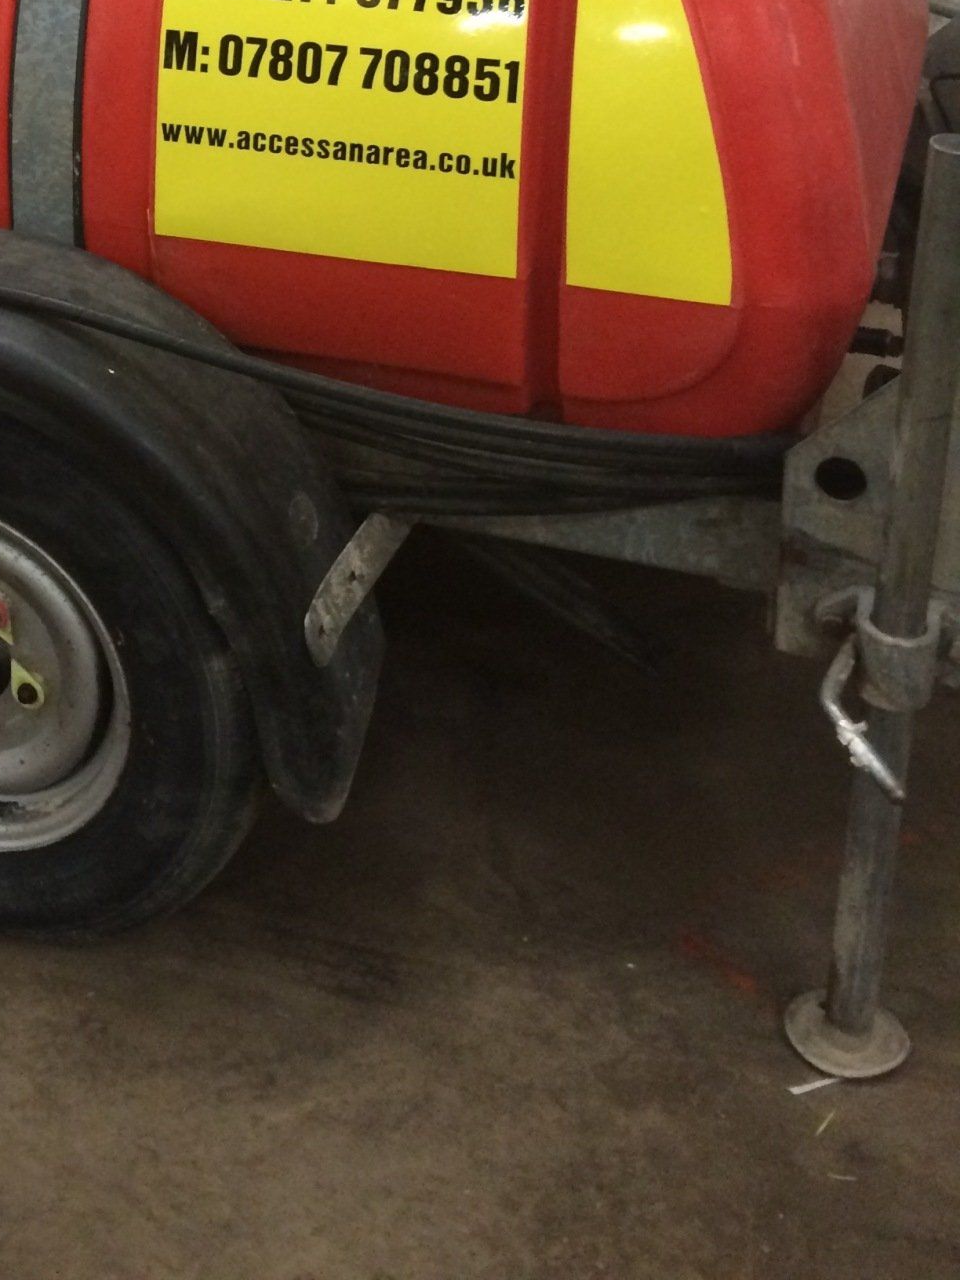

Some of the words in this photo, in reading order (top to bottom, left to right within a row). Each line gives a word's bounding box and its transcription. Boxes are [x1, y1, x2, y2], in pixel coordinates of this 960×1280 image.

[162, 29, 210, 74] M:
[217, 33, 348, 87] 07807
[359, 47, 521, 104] 708851
[161, 122, 516, 180] www.accessanarea.co.uk
